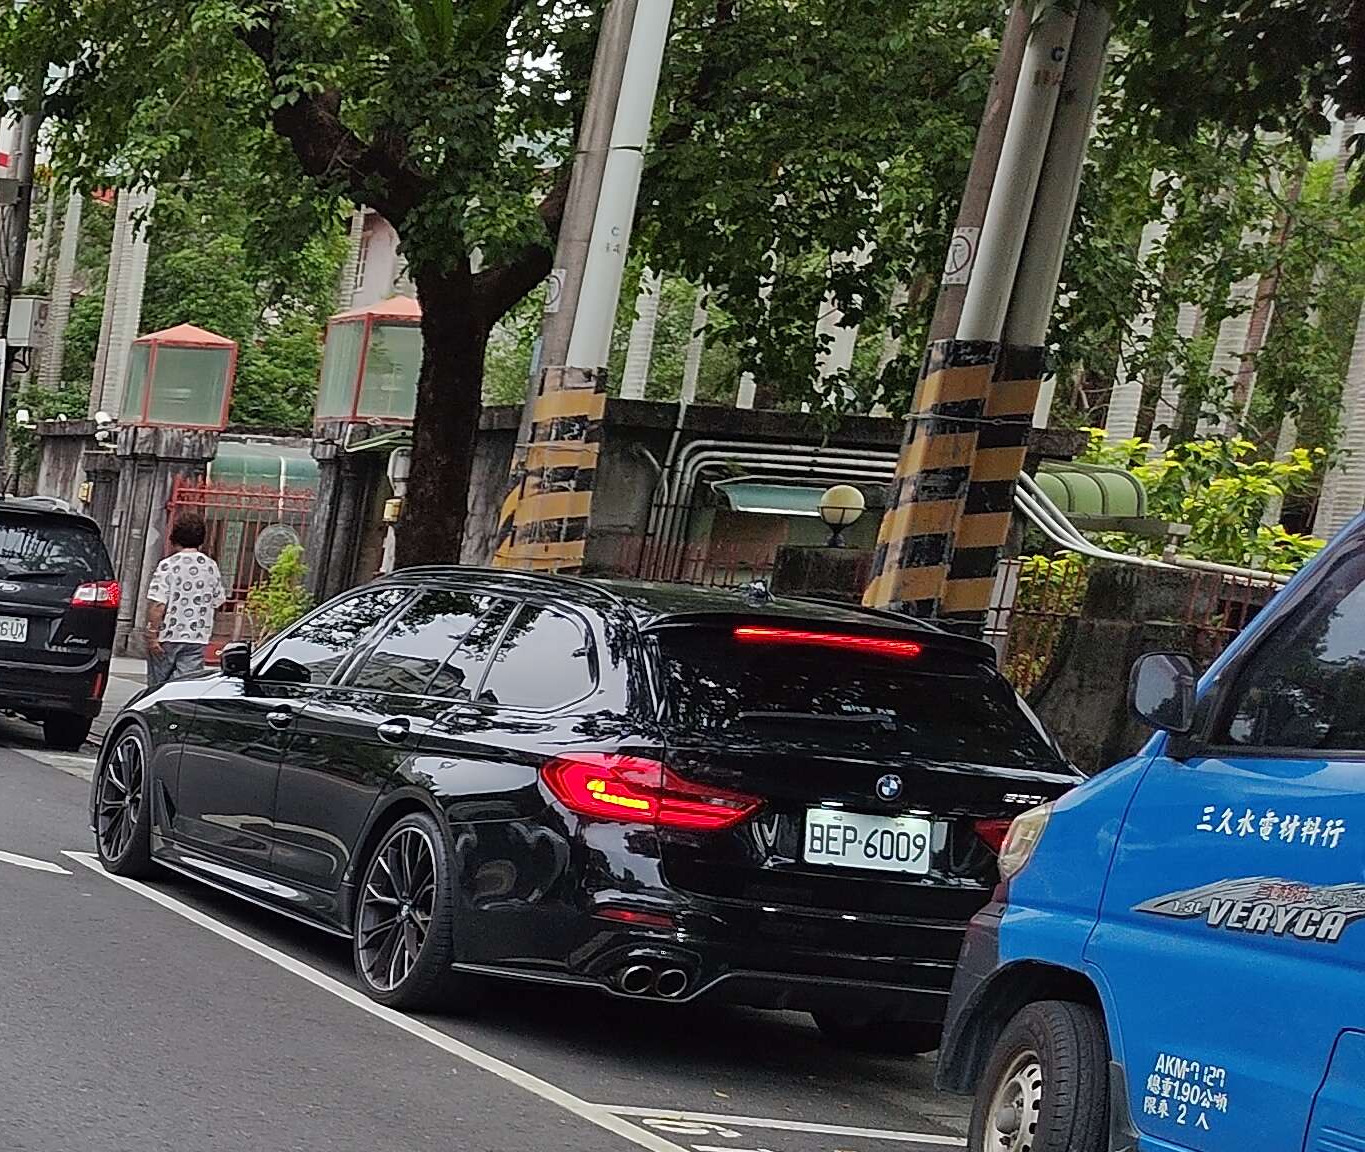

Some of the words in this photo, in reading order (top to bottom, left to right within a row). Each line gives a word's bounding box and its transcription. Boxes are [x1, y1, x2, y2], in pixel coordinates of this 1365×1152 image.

[808, 823, 927, 862] BEP-6009
[1196, 805, 1346, 849] 三久水電材料行
[1171, 900, 1203, 914] 1.3L
[1206, 898, 1348, 942] VERYCA
[1176, 1104, 1187, 1124] 2
[1194, 1111, 1209, 1130] 人
